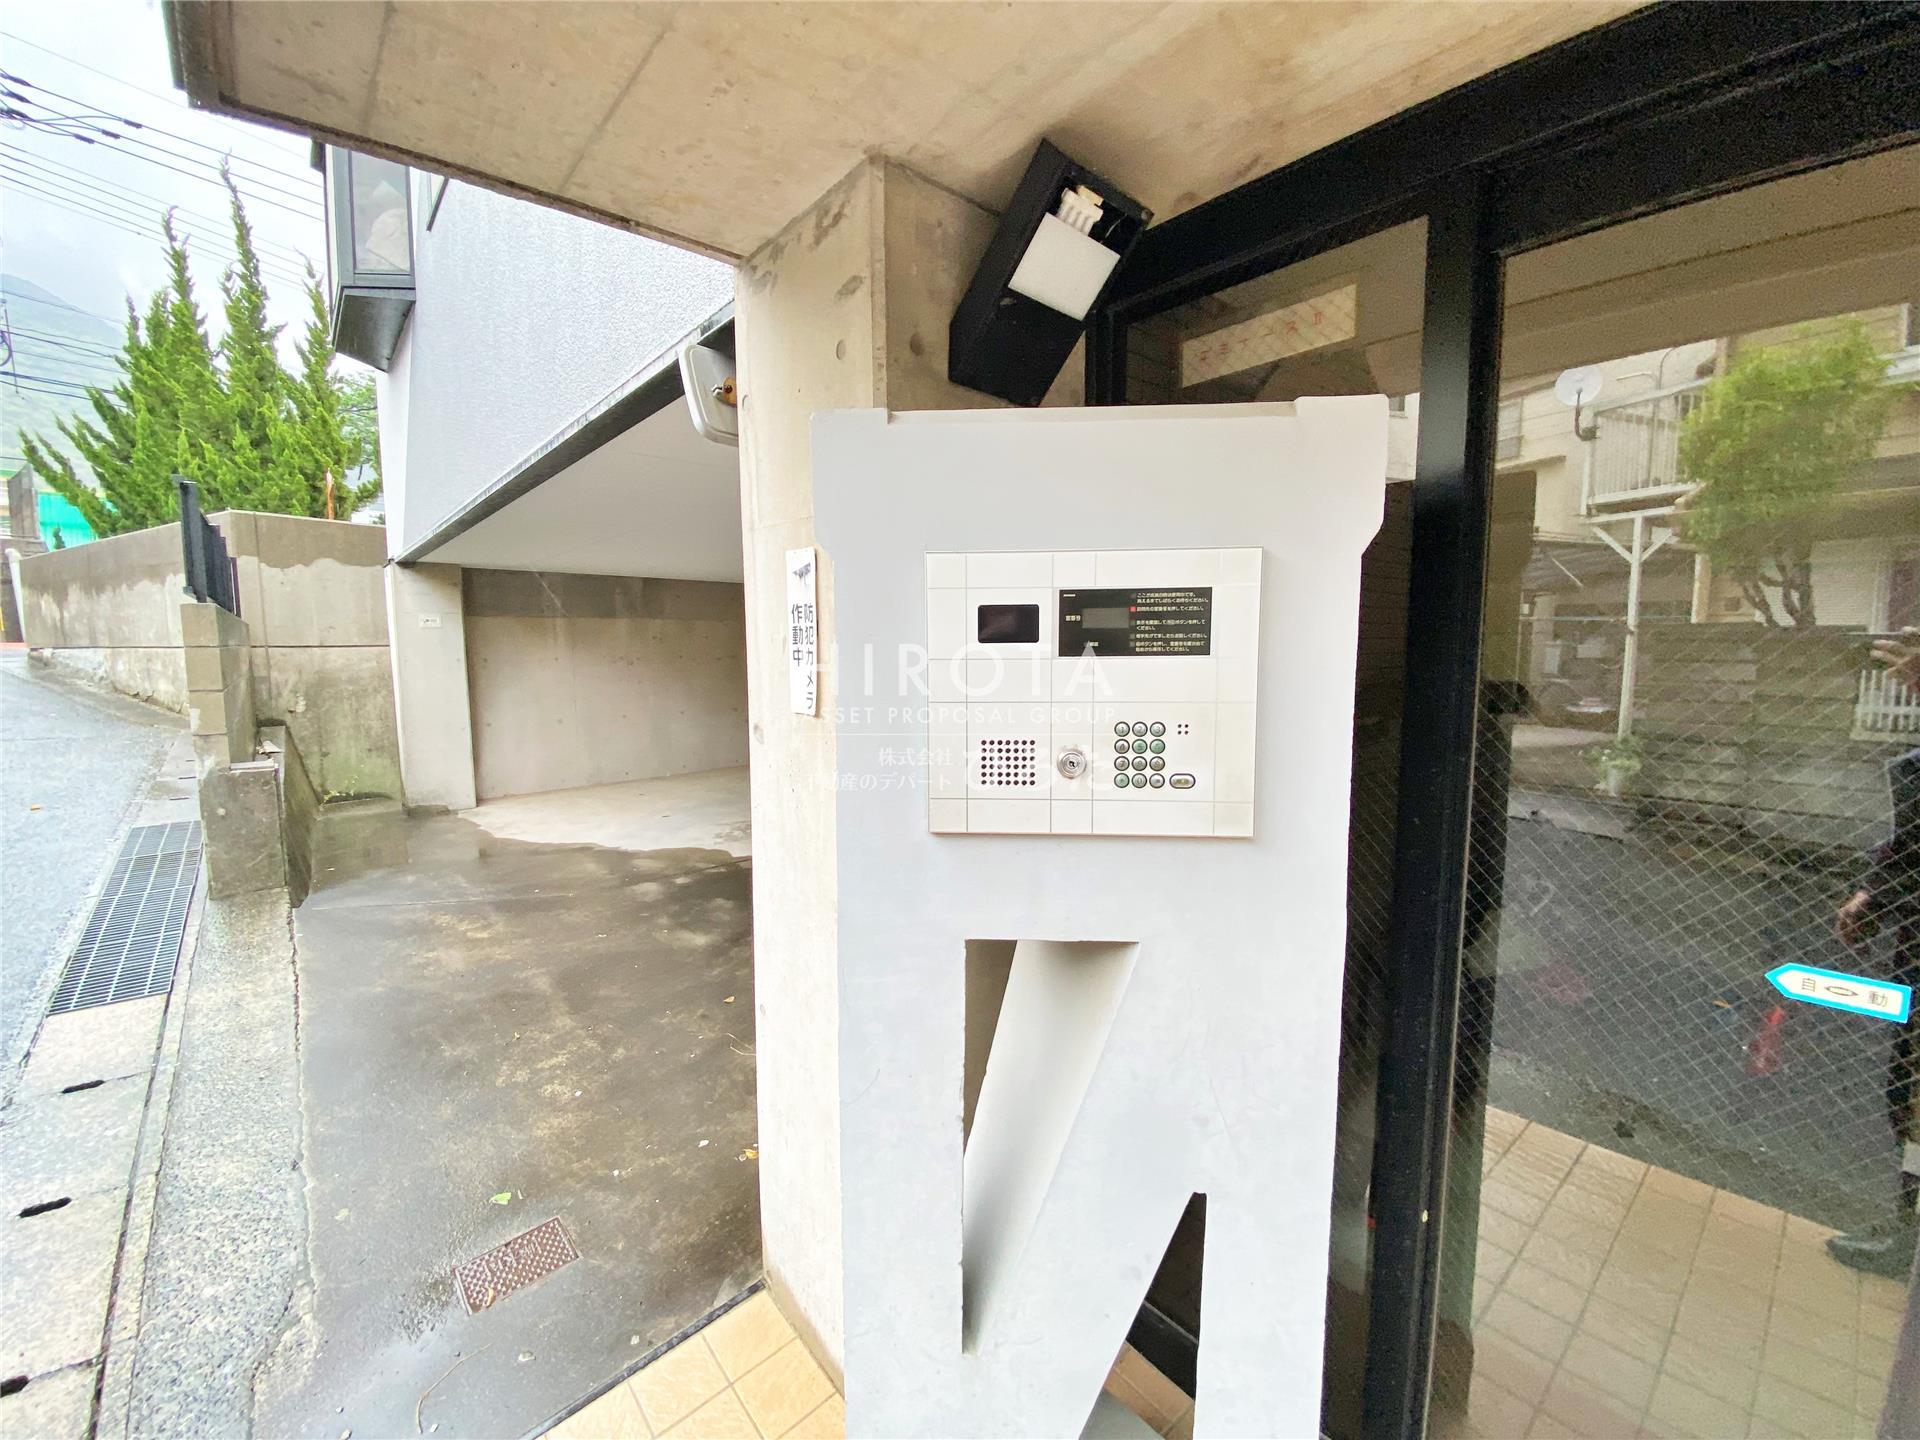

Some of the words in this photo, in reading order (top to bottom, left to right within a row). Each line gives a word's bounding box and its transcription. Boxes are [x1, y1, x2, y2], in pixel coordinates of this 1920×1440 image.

[791, 604, 804, 667] 作動中
[804, 604, 815, 709] 防犯カメラ
